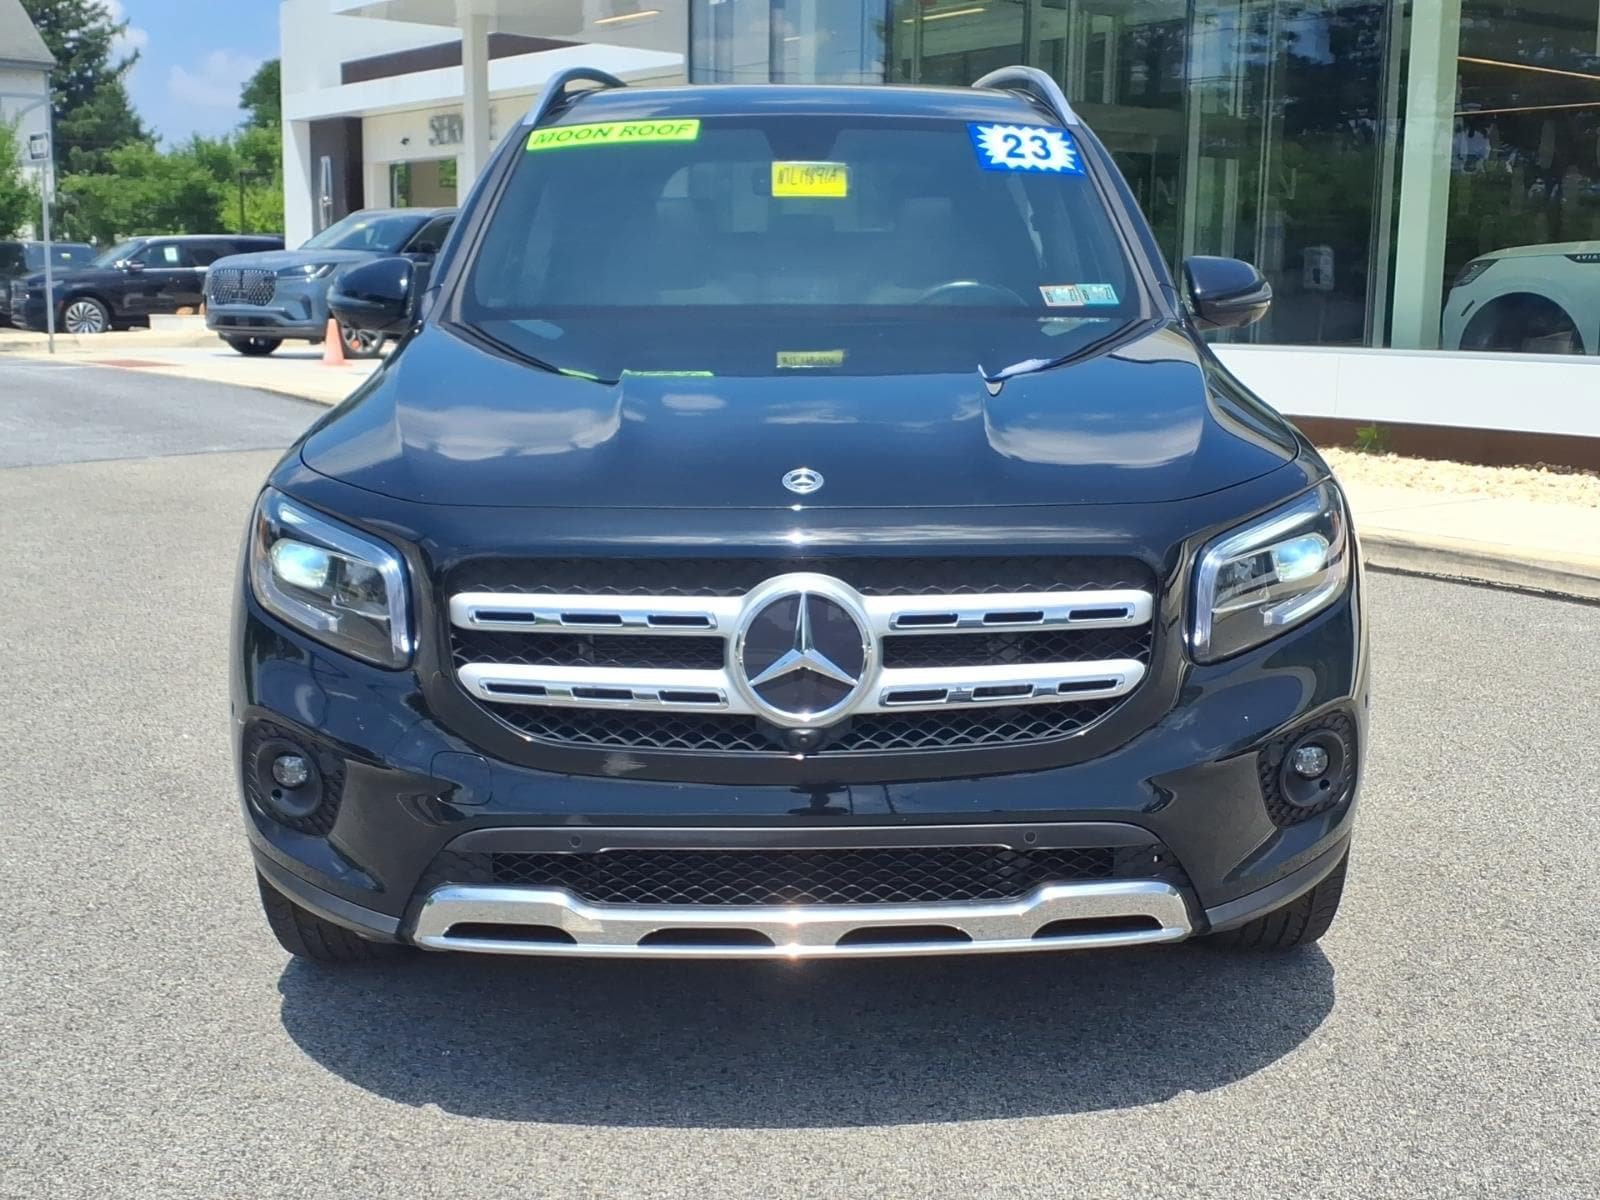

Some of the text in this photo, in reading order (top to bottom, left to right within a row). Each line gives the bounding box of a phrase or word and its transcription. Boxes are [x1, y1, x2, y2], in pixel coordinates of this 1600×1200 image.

[532, 123, 694, 145] MOON ROOF
[1003, 133, 1052, 161] 23
